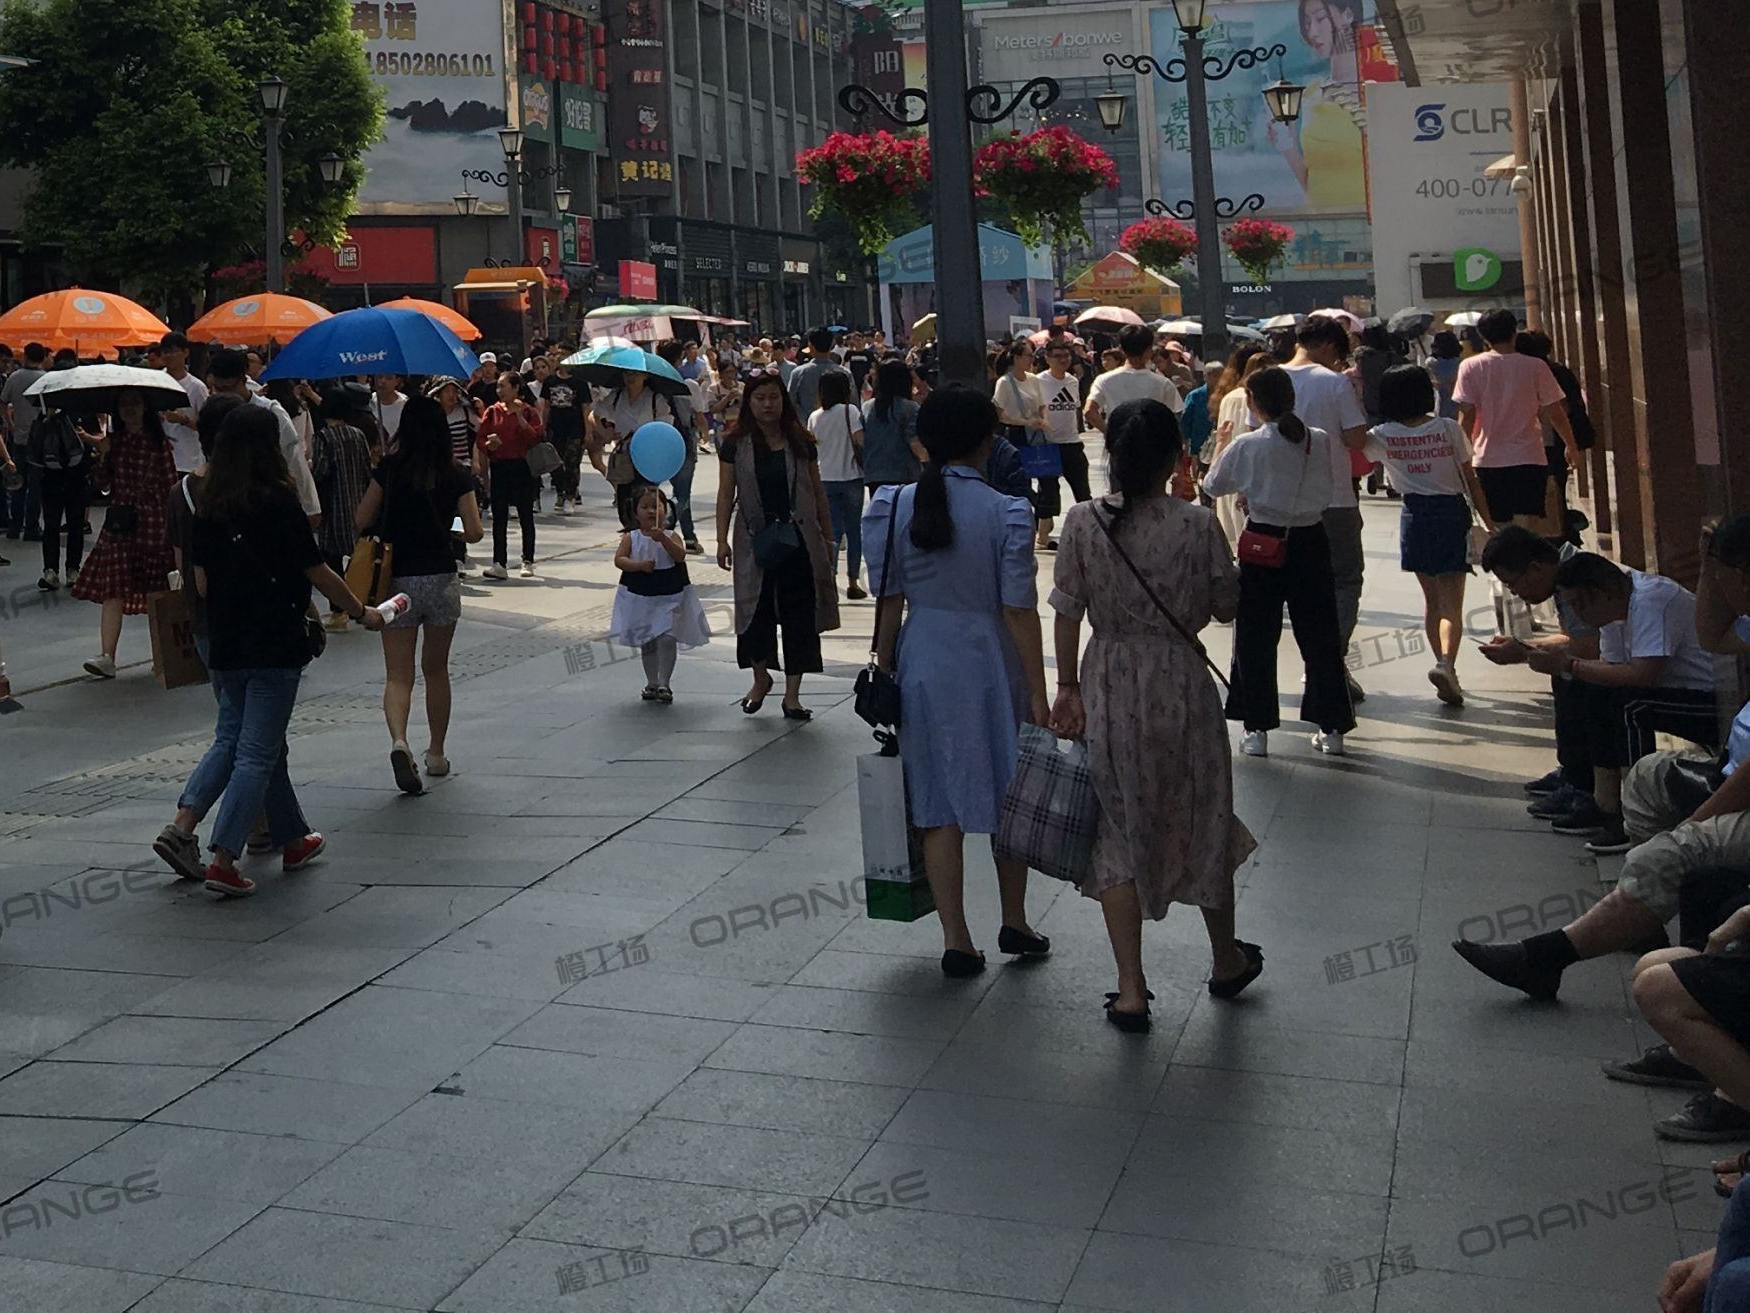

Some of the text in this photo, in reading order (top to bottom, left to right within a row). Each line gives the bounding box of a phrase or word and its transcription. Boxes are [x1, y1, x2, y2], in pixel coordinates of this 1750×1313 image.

[350, 0, 417, 41] 电话
[994, 31, 1123, 50] Meters/bonwe
[1169, 93, 1237, 121] 酷不变
[1162, 115, 1249, 151] 轻有加
[1231, 284, 1273, 294] BOLON
[337, 349, 388, 365] West
[1385, 433, 1449, 448] EXISTENTIAL
[1407, 462, 1432, 475] ONLY
